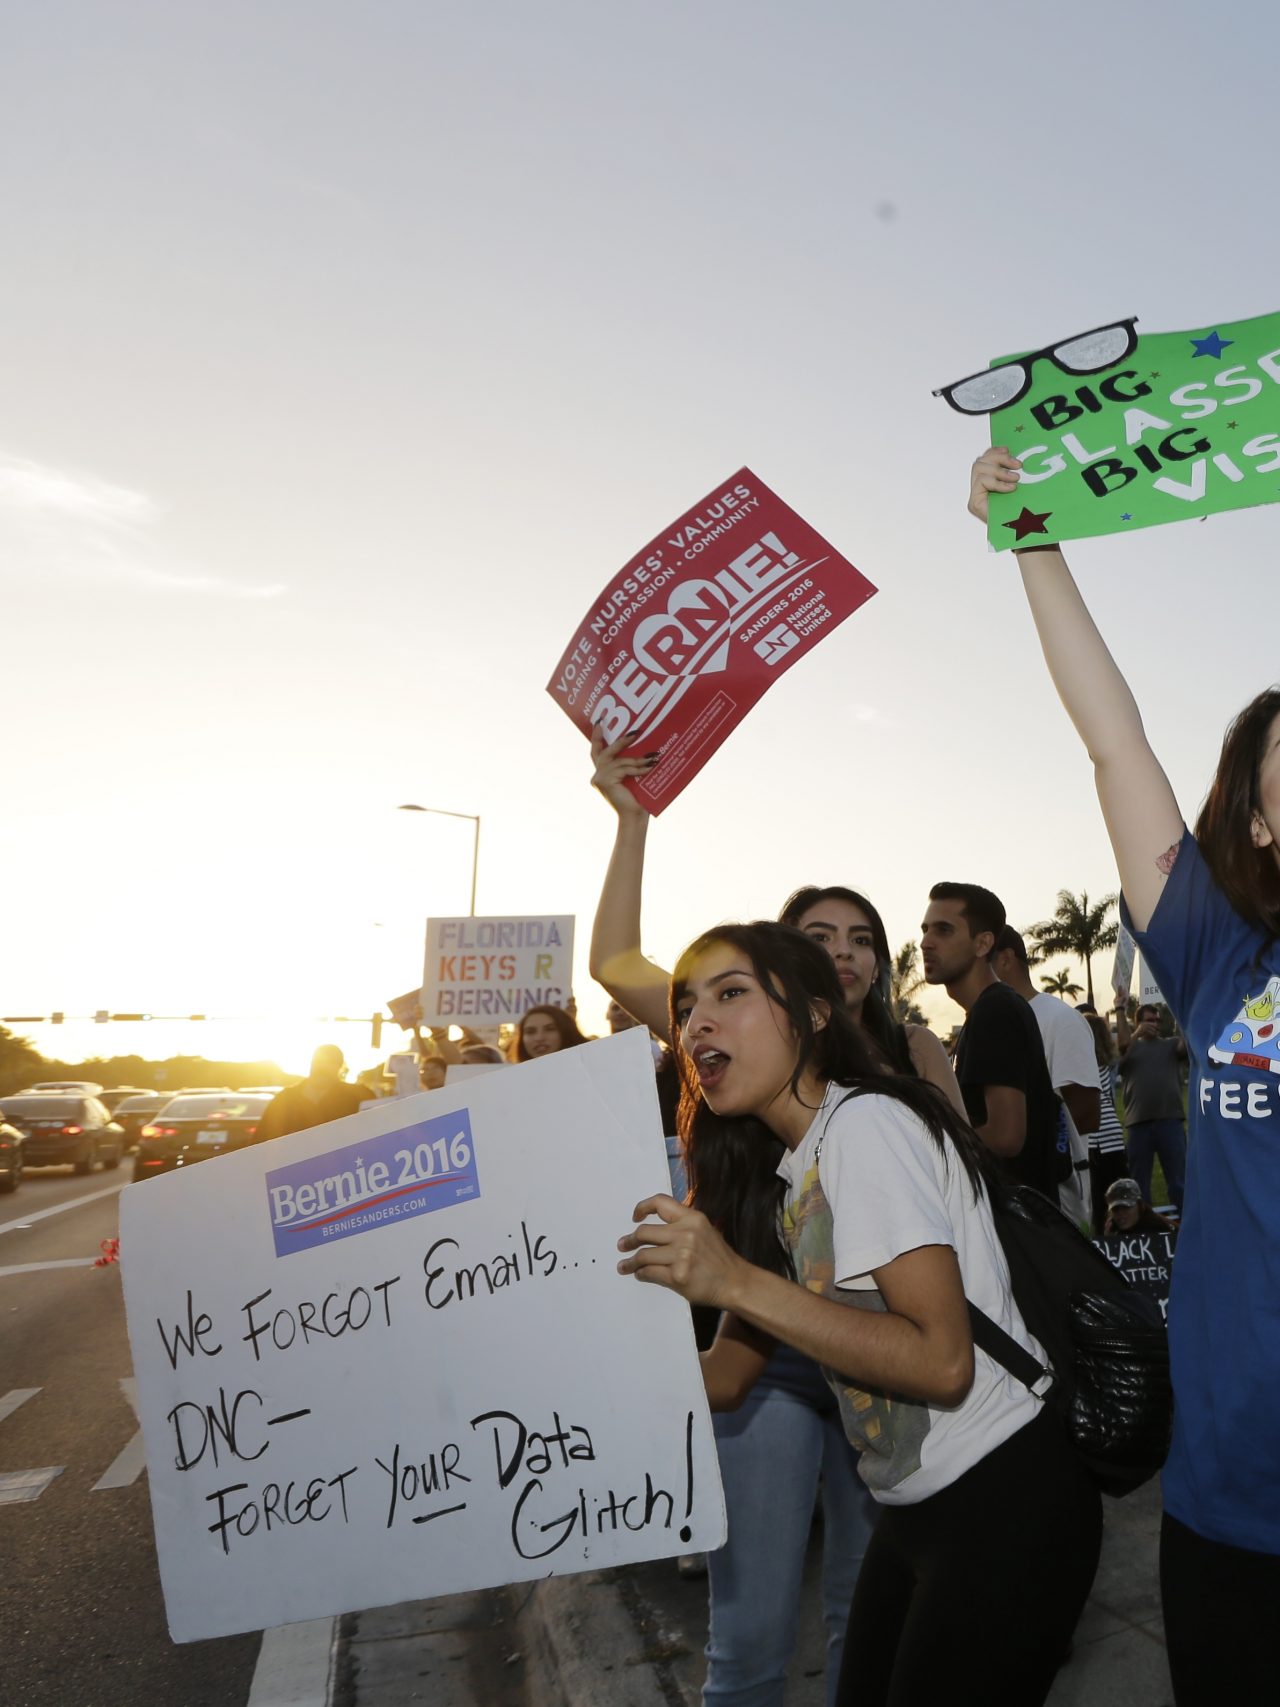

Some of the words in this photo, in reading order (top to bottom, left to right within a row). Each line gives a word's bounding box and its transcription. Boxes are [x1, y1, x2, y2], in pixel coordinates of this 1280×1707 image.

[1030, 370, 1153, 431] BIG
[1080, 427, 1212, 497] BIG
[557, 637, 592, 692] VOTE
[668, 484, 750, 548] VALUES
[567, 655, 597, 705] CARING
[602, 567, 676, 645] COMPASSION
[684, 497, 760, 560] COMMUNITY
[739, 599, 789, 643] SANDERS
[787, 578, 813, 602] 2016
[786, 590, 826, 623] National
[793, 603, 826, 630] Nurses
[590, 531, 800, 746] BERNIE!
[800, 609, 833, 636] United
[583, 673, 609, 717] NURSES
[607, 650, 628, 674] FOR
[438, 921, 562, 949] FLORIDA
[438, 954, 516, 982] KEYS
[534, 954, 553, 980] R
[436, 987, 563, 1016] BERNING
[270, 1156, 390, 1224] Bernie
[394, 1131, 471, 1184] 2016
[322, 1198, 427, 1237] BERNIESANDERS.COM
[1120, 1267, 1169, 1283] TTER
[157, 1290, 222, 1370] We
[241, 1277, 402, 1361] FORGOT
[206, 1466, 359, 1555] FORGET
[470, 1411, 596, 1490] Data
[512, 1411, 694, 1559] Glitch!
